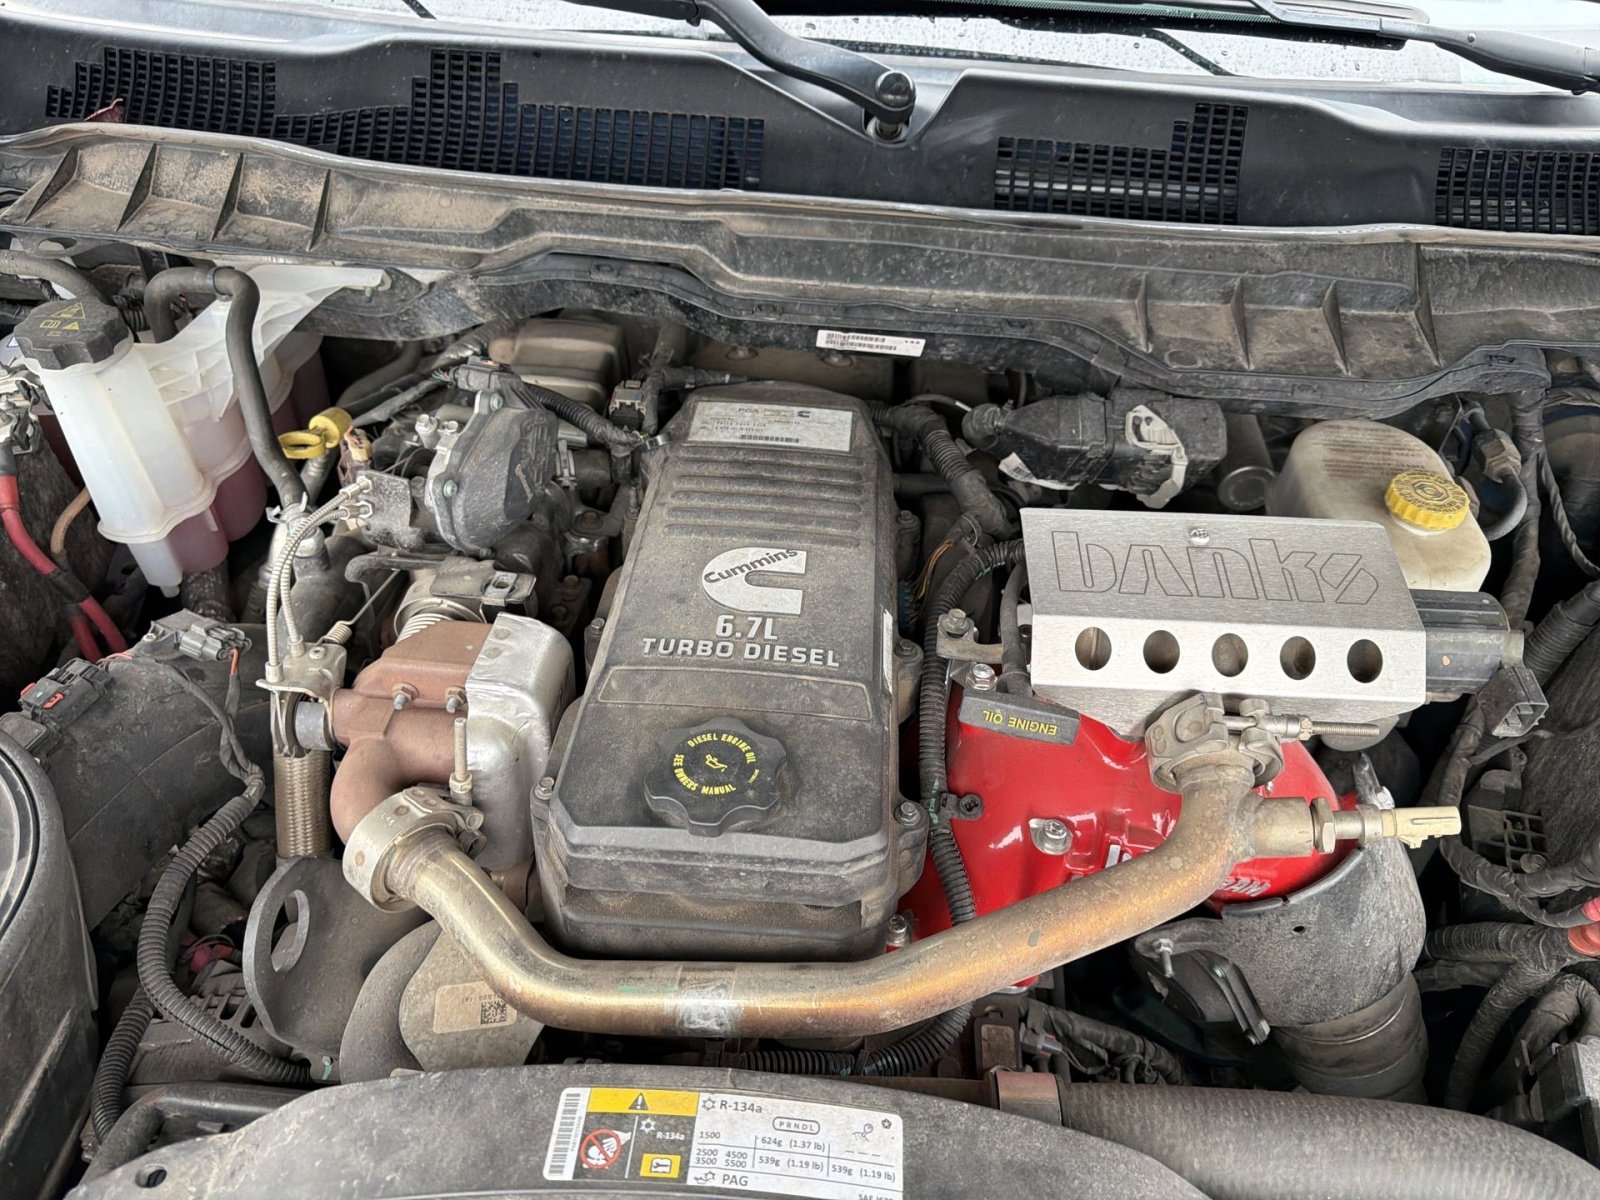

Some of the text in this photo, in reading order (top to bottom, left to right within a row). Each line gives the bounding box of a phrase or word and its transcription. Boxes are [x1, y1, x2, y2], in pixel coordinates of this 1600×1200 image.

[703, 549, 798, 584] Cummins
[1051, 530, 1379, 605] banks
[715, 614, 778, 640] 6.7L
[641, 637, 840, 667] TURBO DIESEL
[983, 709, 1058, 736] ENGINE OIL
[687, 733, 756, 764] DIESEL ENGINE OIL
[673, 753, 737, 795] SEE OWNERS MANUAL
[719, 1099, 762, 1113] R-134a
[656, 1131, 685, 1141] R-134a
[699, 1131, 721, 1139] 1500
[761, 1136, 826, 1152] 624g (1.37 lb)
[696, 1148, 748, 1159] 2500 4500
[695, 1157, 747, 1168] 3500 5500
[759, 1156, 824, 1172] 539g (1.19 lb)
[722, 1174, 749, 1187] PAG
[831, 1164, 896, 1183] 539g (1.19 lb)
